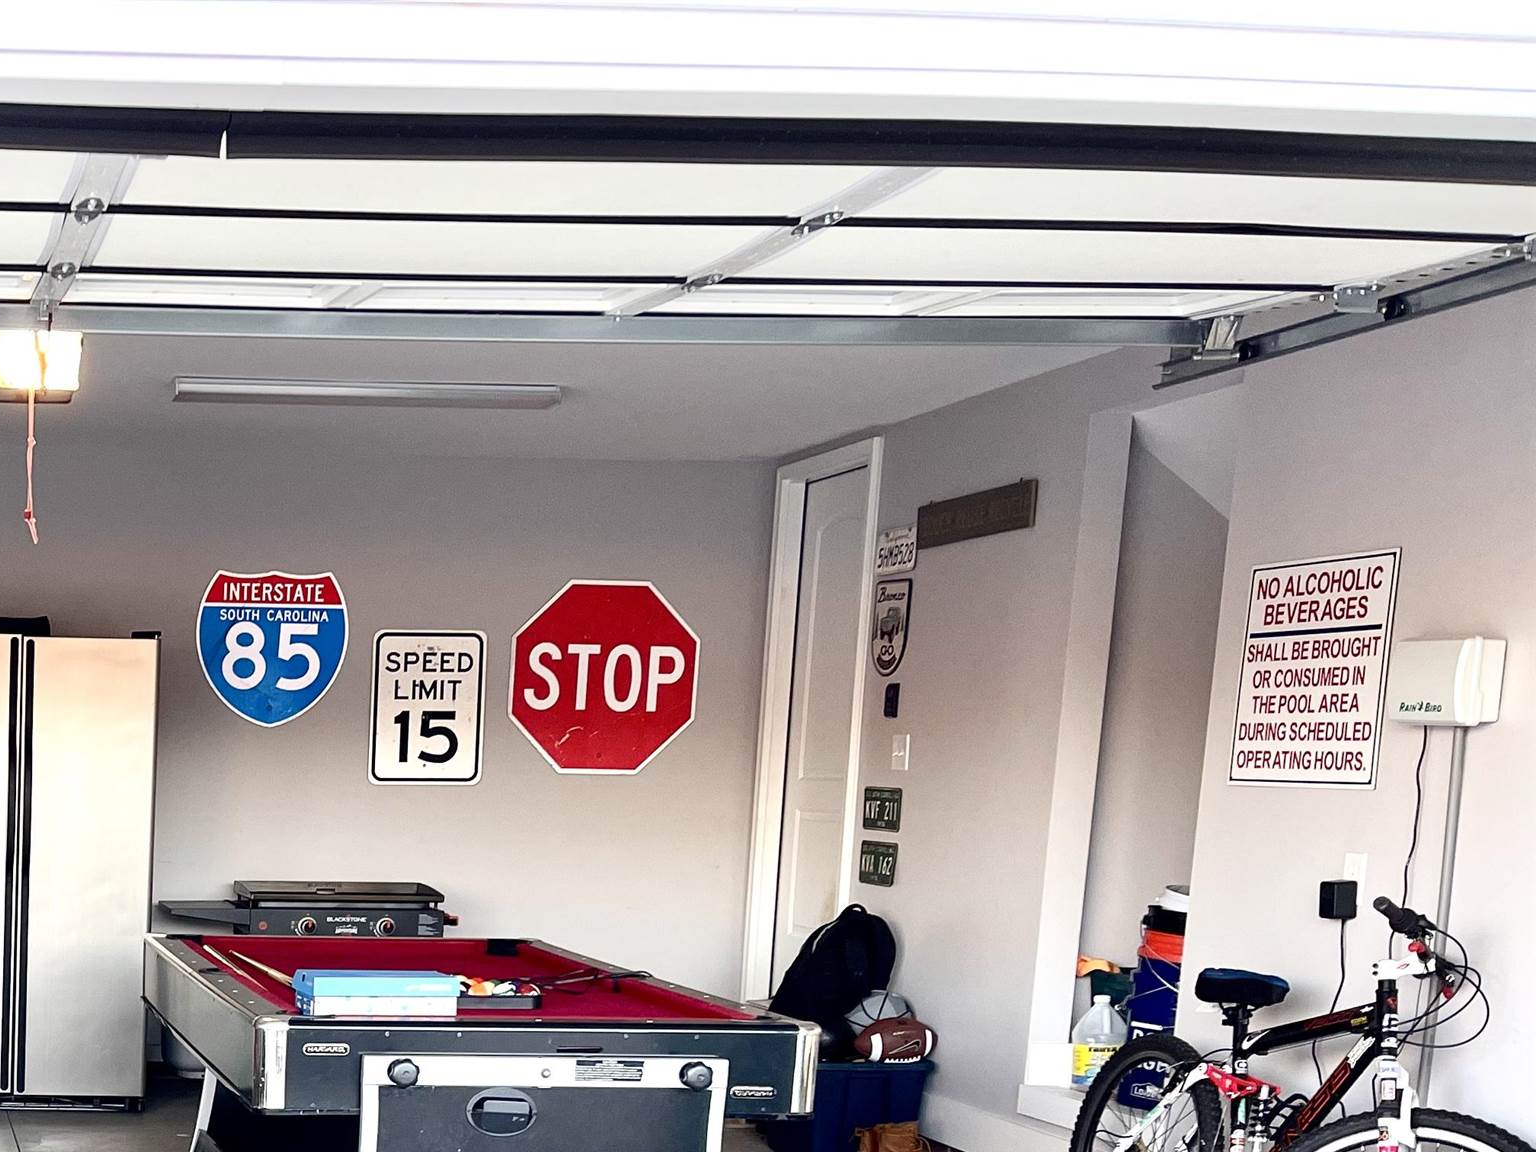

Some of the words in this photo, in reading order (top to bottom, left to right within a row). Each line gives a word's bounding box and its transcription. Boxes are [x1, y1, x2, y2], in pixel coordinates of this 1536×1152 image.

[224, 582, 325, 603] INTERSTATE
[1257, 577, 1281, 600] NO
[1283, 565, 1384, 598] ALCOHOLIC
[220, 609, 260, 621] SOUTH
[266, 610, 329, 622] CAROLINA
[1263, 595, 1369, 626] BEVERAGES
[221, 621, 321, 691] 85
[1247, 642, 1289, 663] SHALL
[1291, 641, 1310, 660] BE
[1311, 636, 1382, 660] BROUGHT
[385, 651, 474, 673] SPEED
[523, 642, 686, 713] STOP
[1252, 670, 1272, 689] OR
[1274, 666, 1350, 688] CONSUMED
[1351, 665, 1367, 686] IN
[394, 679, 462, 701] LIMIT
[1252, 695, 1277, 714] THE
[1277, 694, 1315, 714] POOL
[1318, 693, 1360, 713] AREA
[393, 710, 459, 764] 15
[1238, 722, 1287, 741] DURING
[1289, 721, 1372, 742] SCHEDULED
[1236, 750, 1312, 770] OPERATING
[1314, 751, 1367, 771] HOURS.
